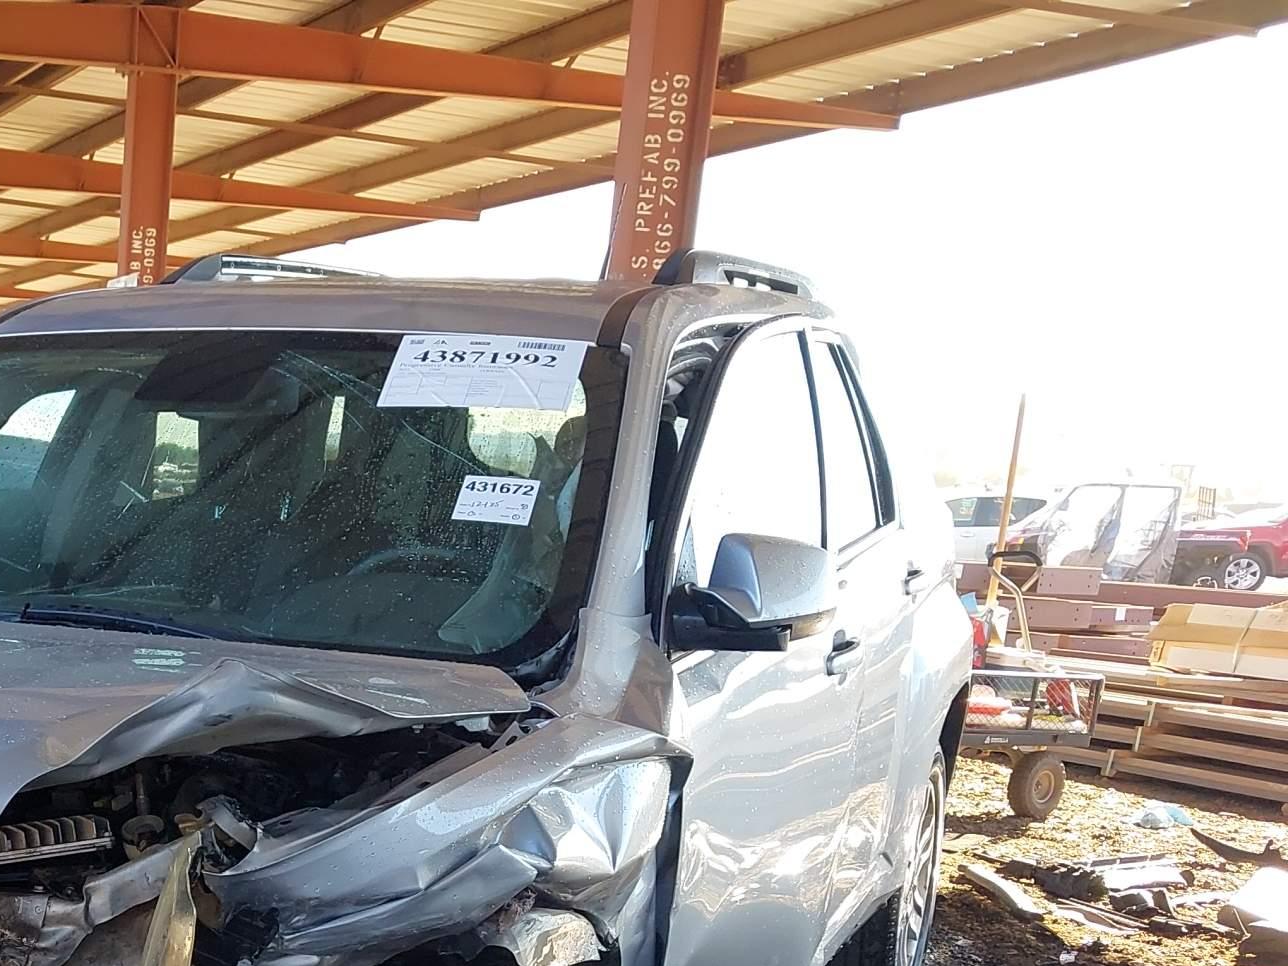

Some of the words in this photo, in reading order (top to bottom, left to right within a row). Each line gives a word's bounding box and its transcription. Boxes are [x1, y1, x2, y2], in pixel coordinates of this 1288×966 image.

[635, 134, 661, 232] PREFAB
[648, 71, 669, 118] INC.
[653, 74, 690, 270] 866-799-0969
[413, 349, 558, 369] 43871992
[465, 481, 535, 496] 431672
